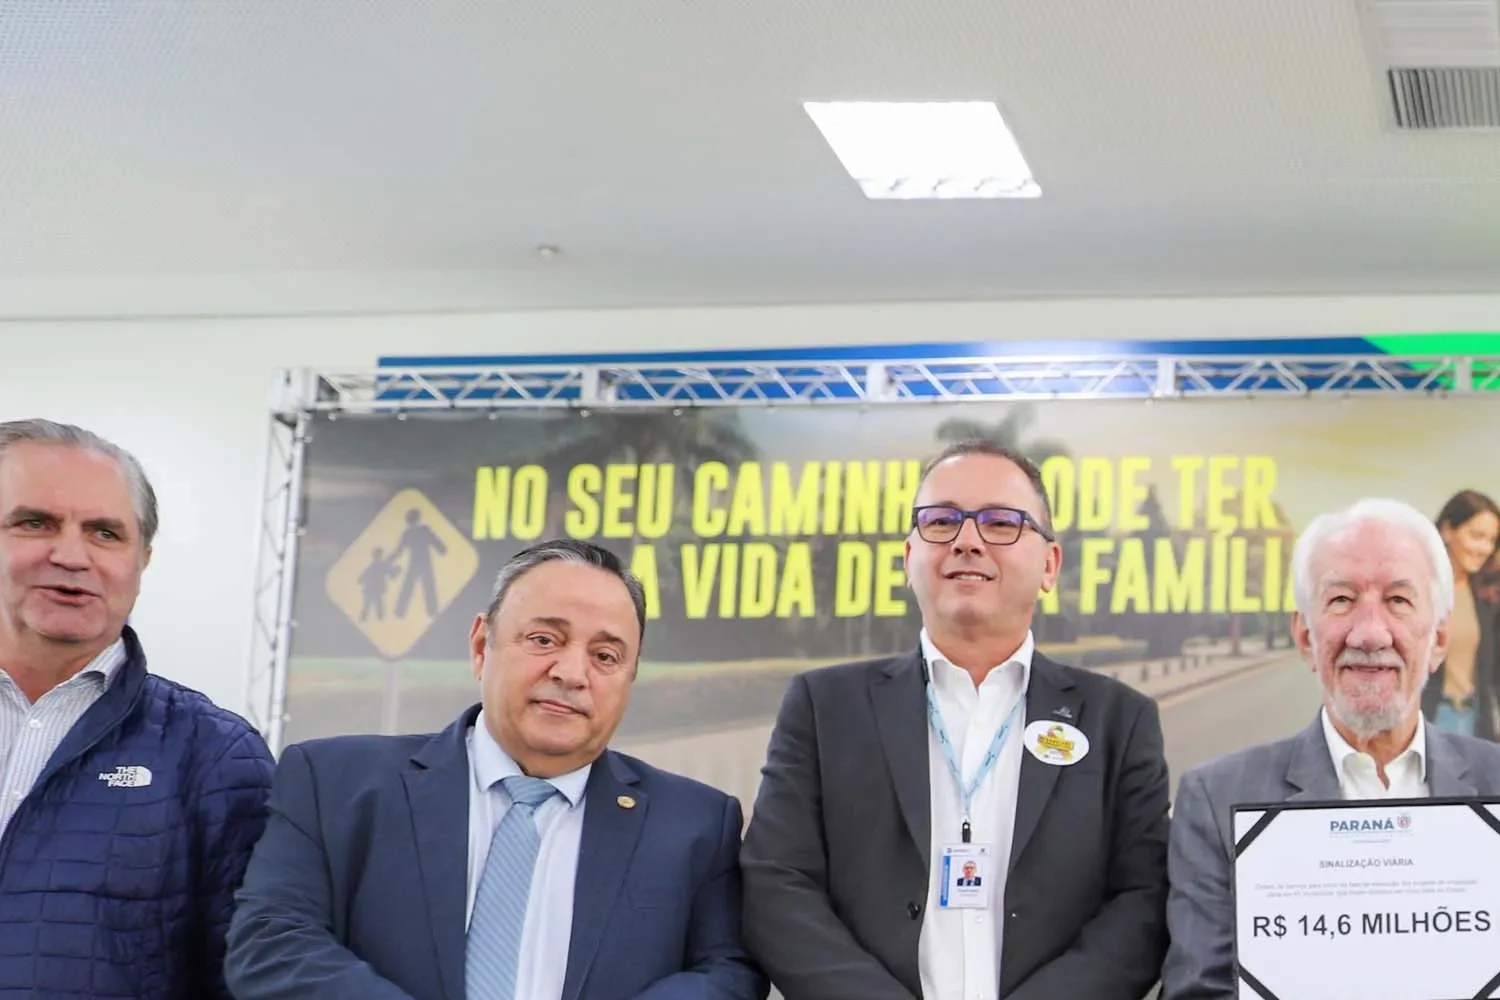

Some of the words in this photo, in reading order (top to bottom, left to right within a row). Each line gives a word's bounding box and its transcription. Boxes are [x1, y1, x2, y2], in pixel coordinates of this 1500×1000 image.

[472, 465, 548, 540] NO
[565, 462, 676, 539] SEU
[692, 459, 922, 537] CAMINH
[1041, 455, 1152, 533] ODE
[1172, 455, 1279, 531] TER
[680, 542, 816, 619] VIDA
[834, 541, 908, 618] DE
[1080, 520, 1295, 615] FAMÍLI
[1329, 816, 1395, 832] PARANÁ
[1319, 858, 1381, 870] SINALIZAÇÃO
[1253, 914, 1287, 939] R$
[1298, 913, 1352, 939] 14,6
[1362, 906, 1491, 935] MILHÕES
